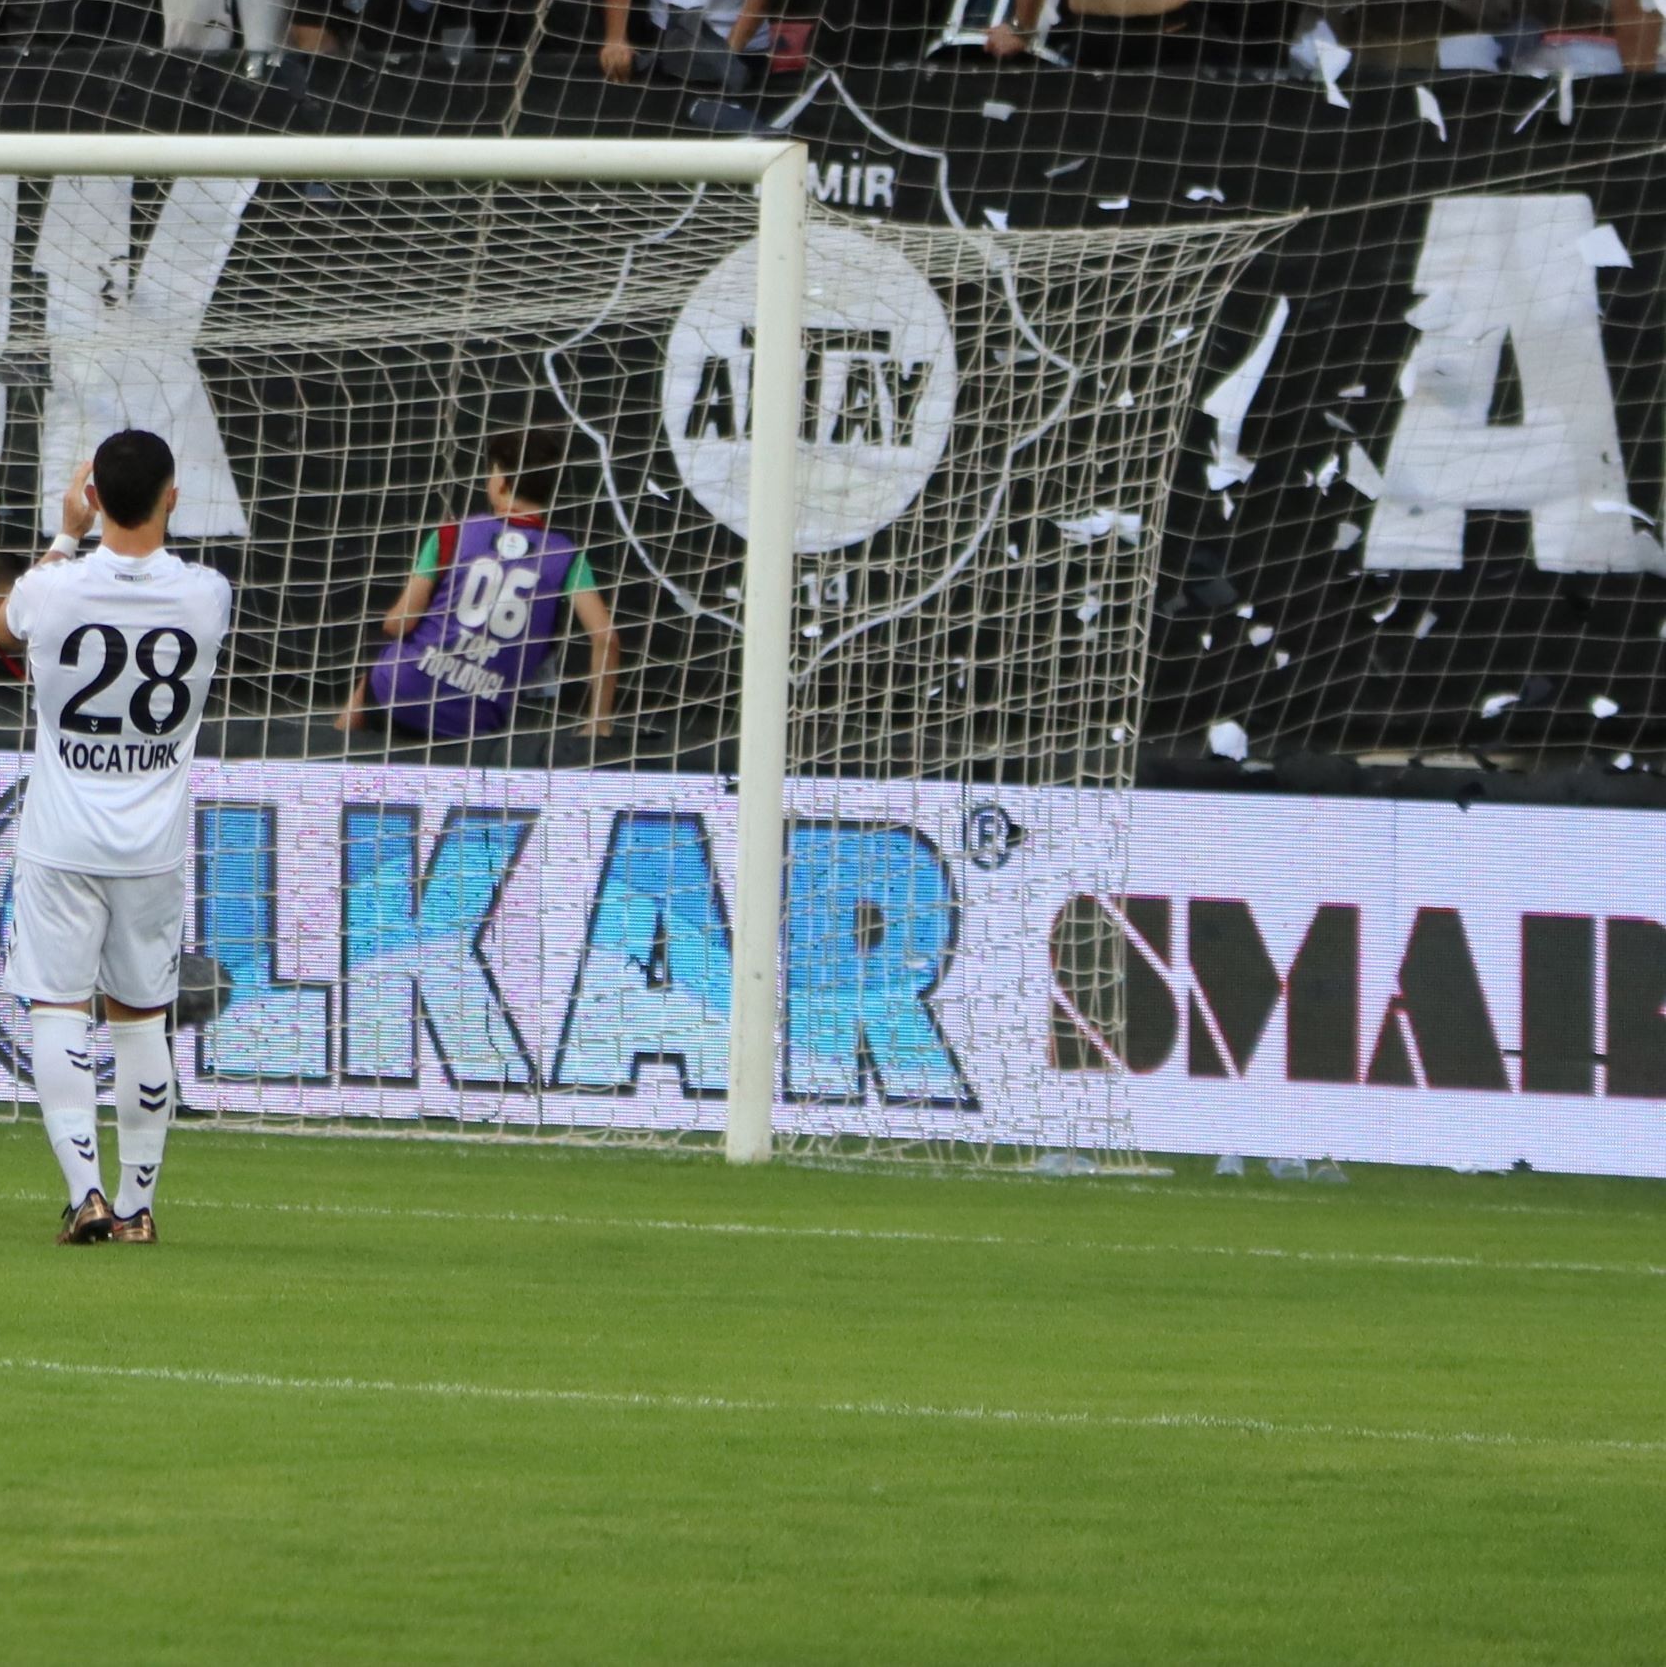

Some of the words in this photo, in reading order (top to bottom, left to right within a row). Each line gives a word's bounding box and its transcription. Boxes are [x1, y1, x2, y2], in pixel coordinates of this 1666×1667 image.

[455, 556, 540, 640] 06
[453, 627, 501, 667] TOP
[58, 622, 199, 736] 28
[58, 737, 182, 773] KOCATÜRK
